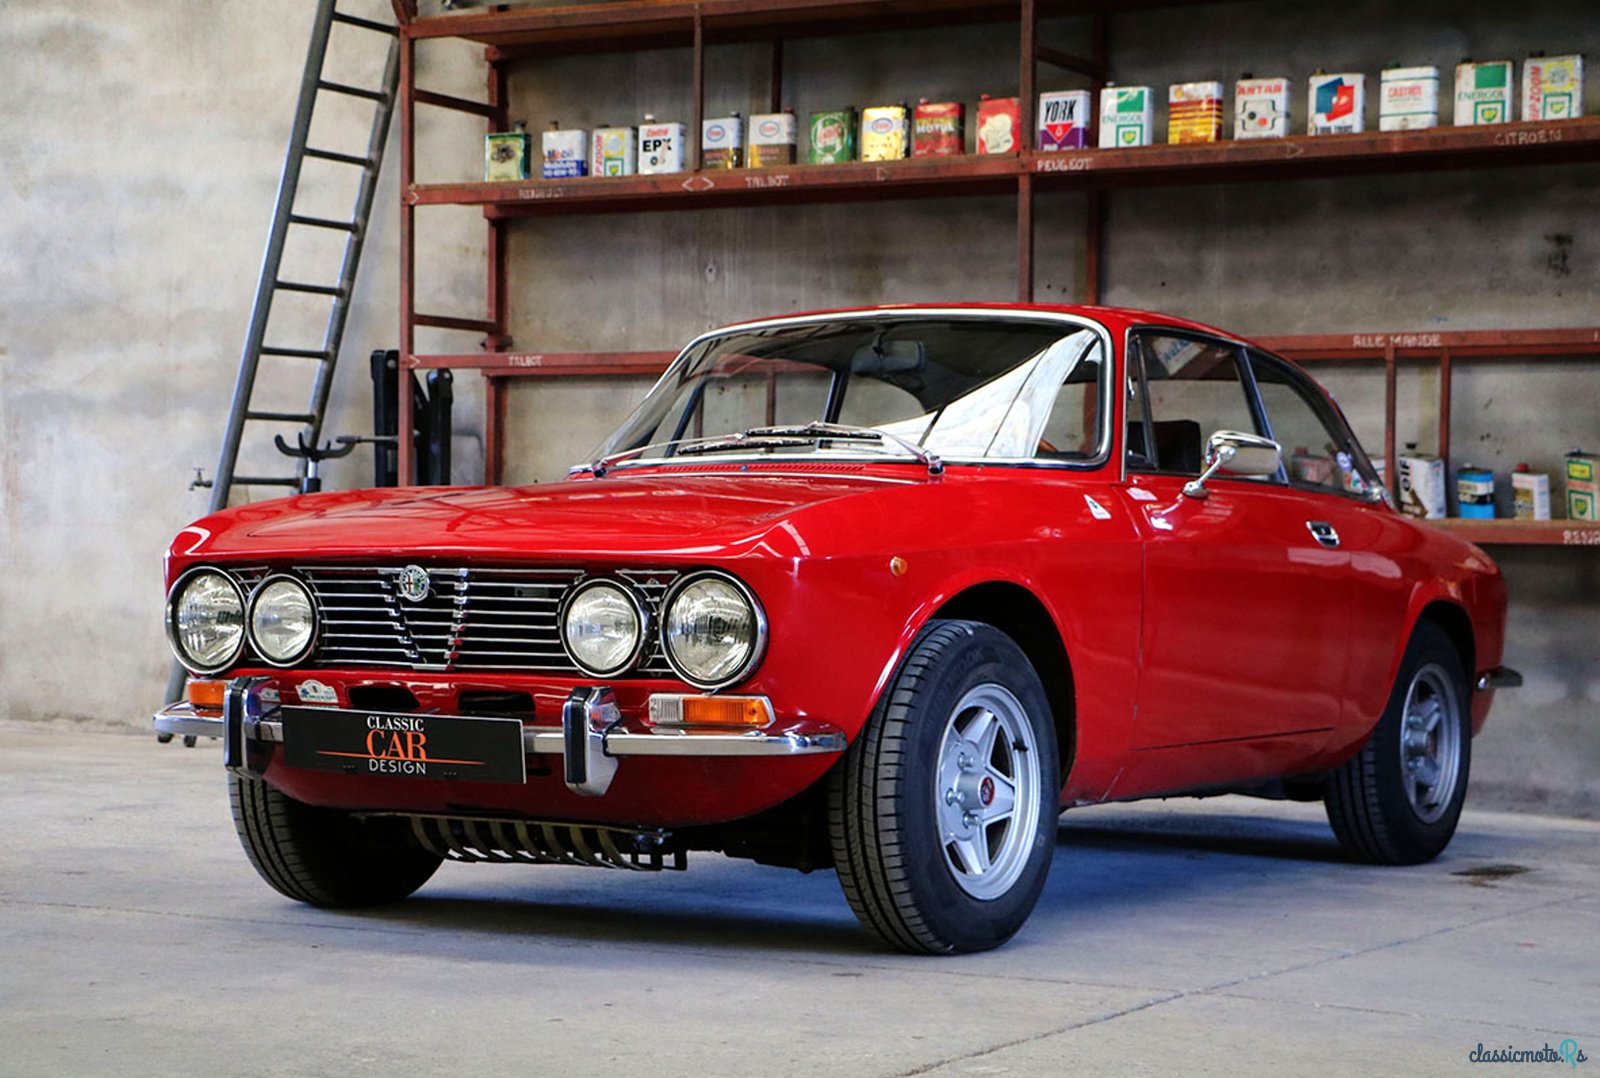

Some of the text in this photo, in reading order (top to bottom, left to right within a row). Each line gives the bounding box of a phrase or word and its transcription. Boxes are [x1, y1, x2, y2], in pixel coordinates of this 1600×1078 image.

[1237, 85, 1283, 96] ANTAR
[1458, 90, 1505, 101] ENERGOL
[1044, 99, 1077, 122] YORK
[916, 123, 955, 133] MOTUL
[1494, 128, 1562, 145] CITROEN
[643, 138, 672, 152] EPX
[1037, 158, 1093, 172] PEUGEOT
[745, 174, 789, 188] TALBOT
[508, 355, 543, 366] TALBOT
[367, 715, 424, 732] CLASSIC
[366, 729, 427, 762] CAR
[369, 758, 426, 775] DESIGN
